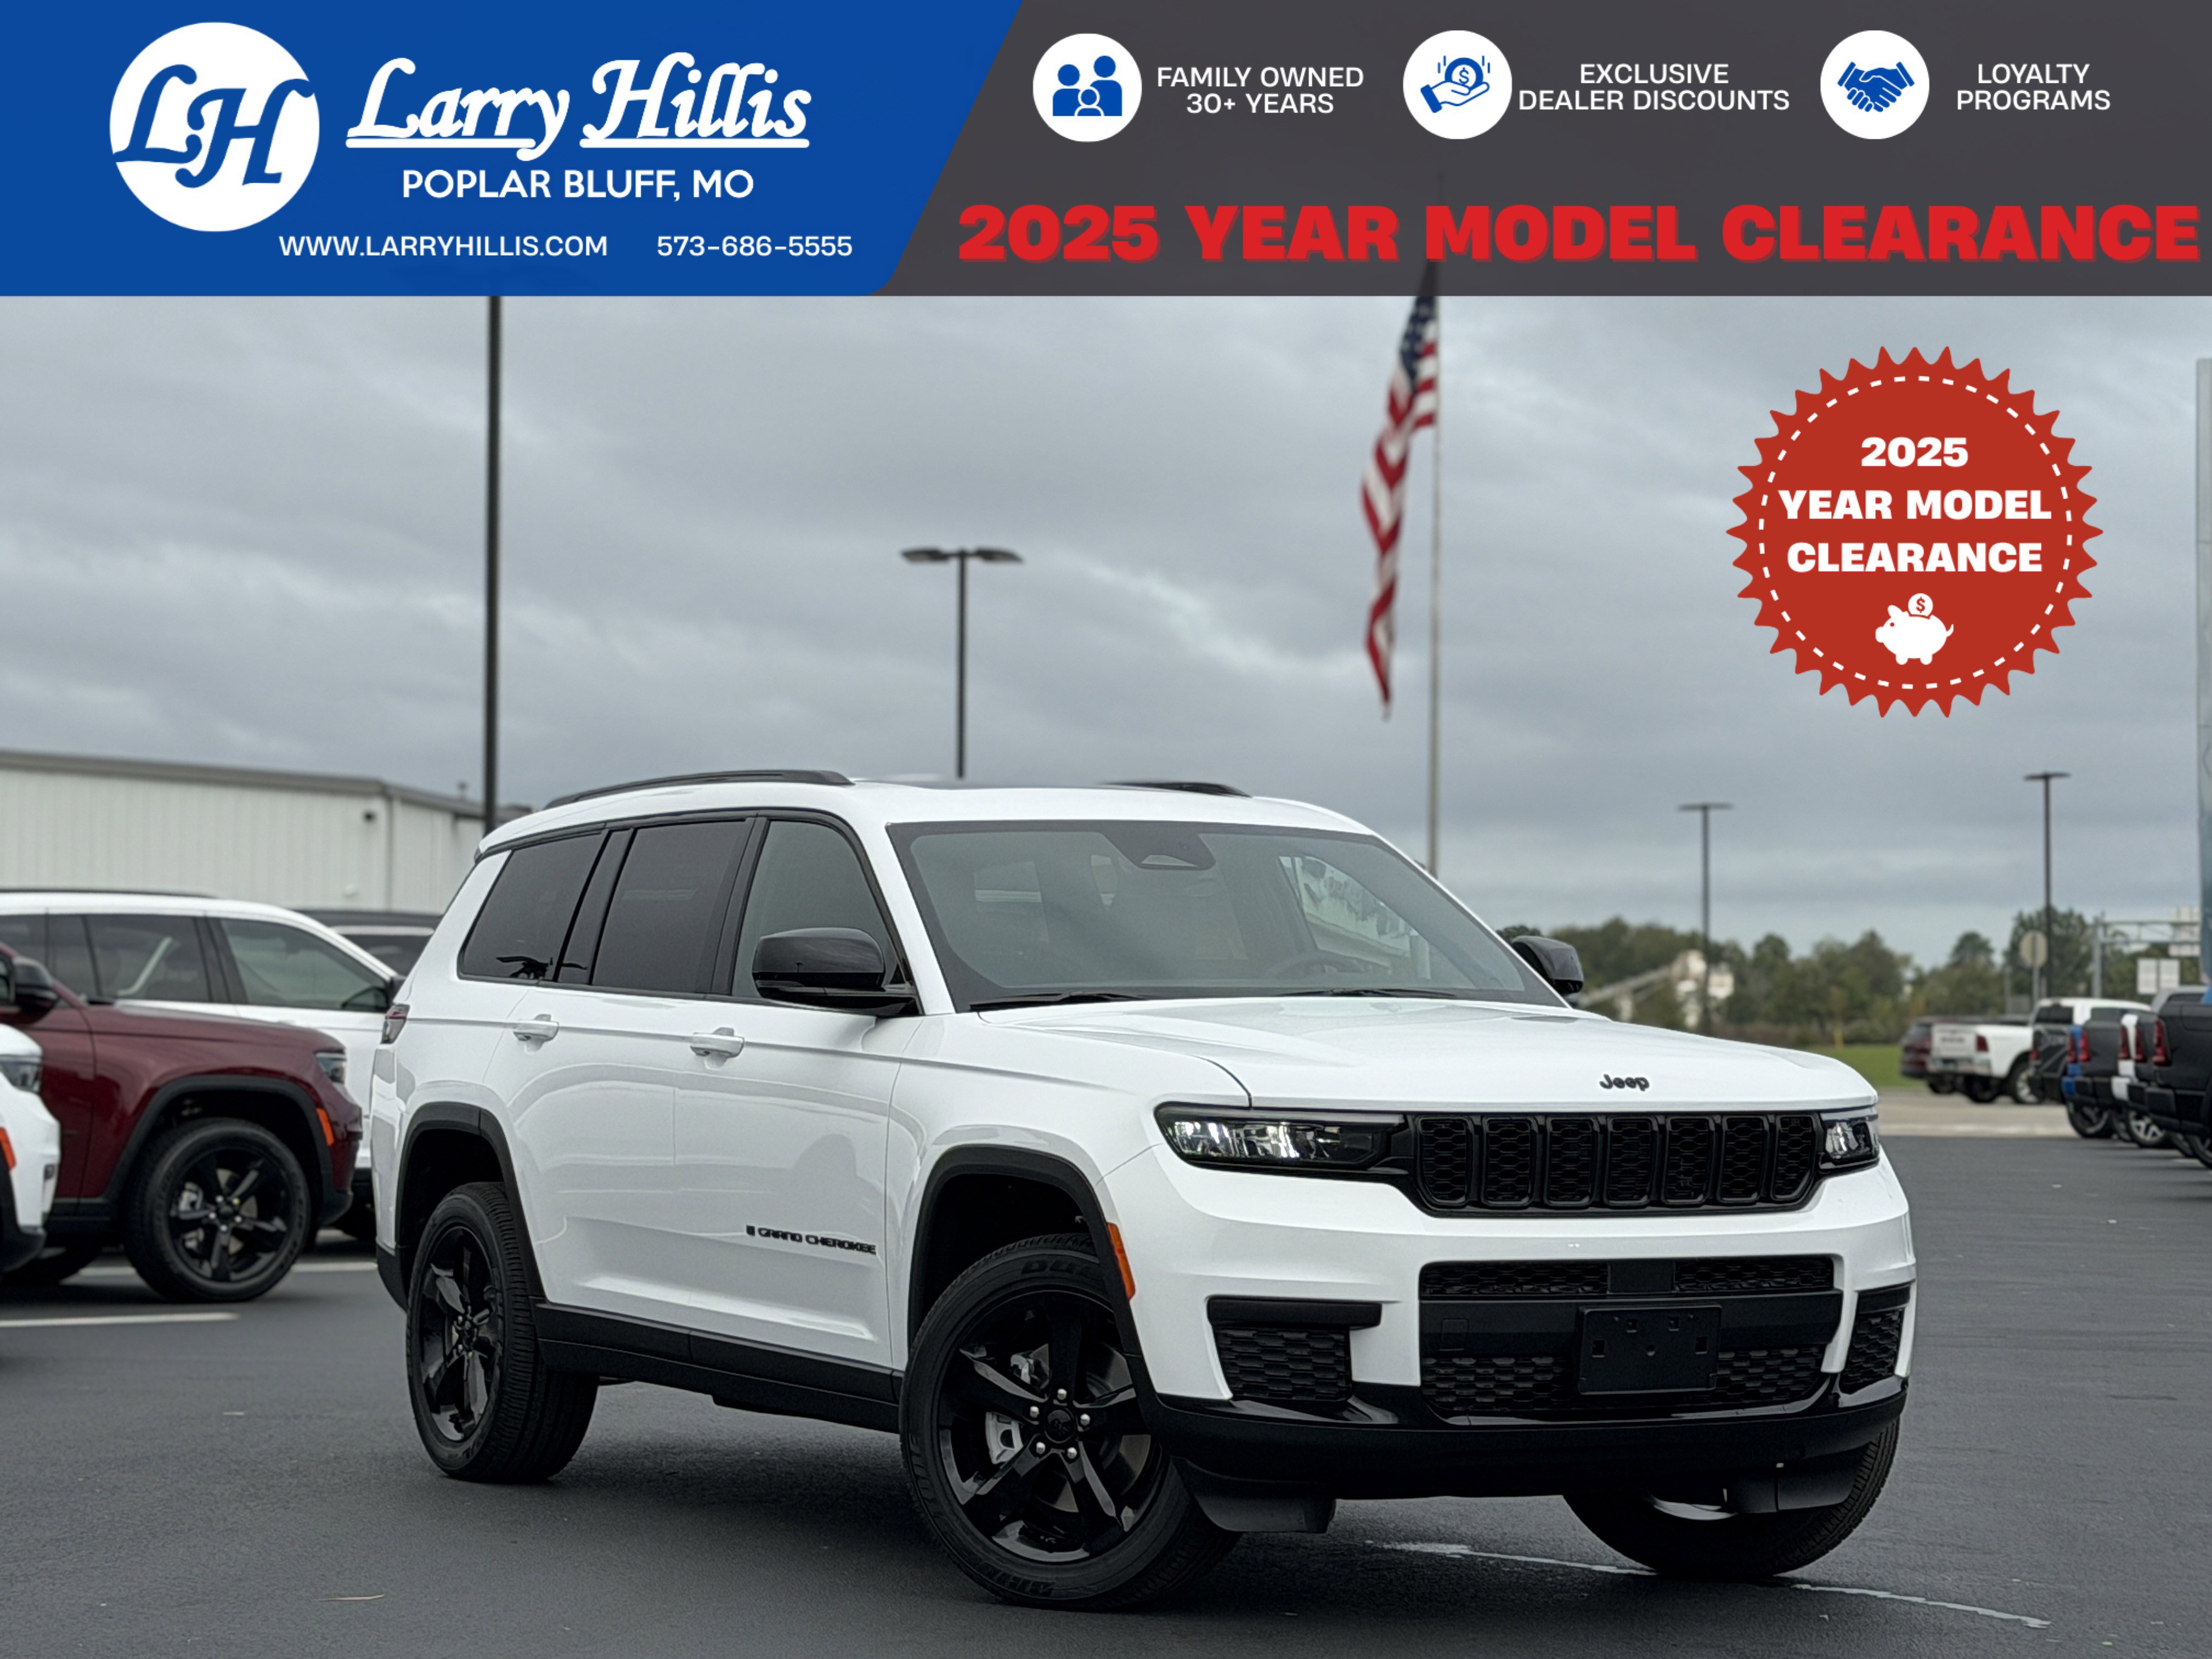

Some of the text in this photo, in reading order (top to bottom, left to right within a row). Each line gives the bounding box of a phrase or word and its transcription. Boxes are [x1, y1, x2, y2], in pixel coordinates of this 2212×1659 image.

[1599, 1074, 1650, 1092] Jeep
[758, 1227, 877, 1256] GRAND CHEROKEE
